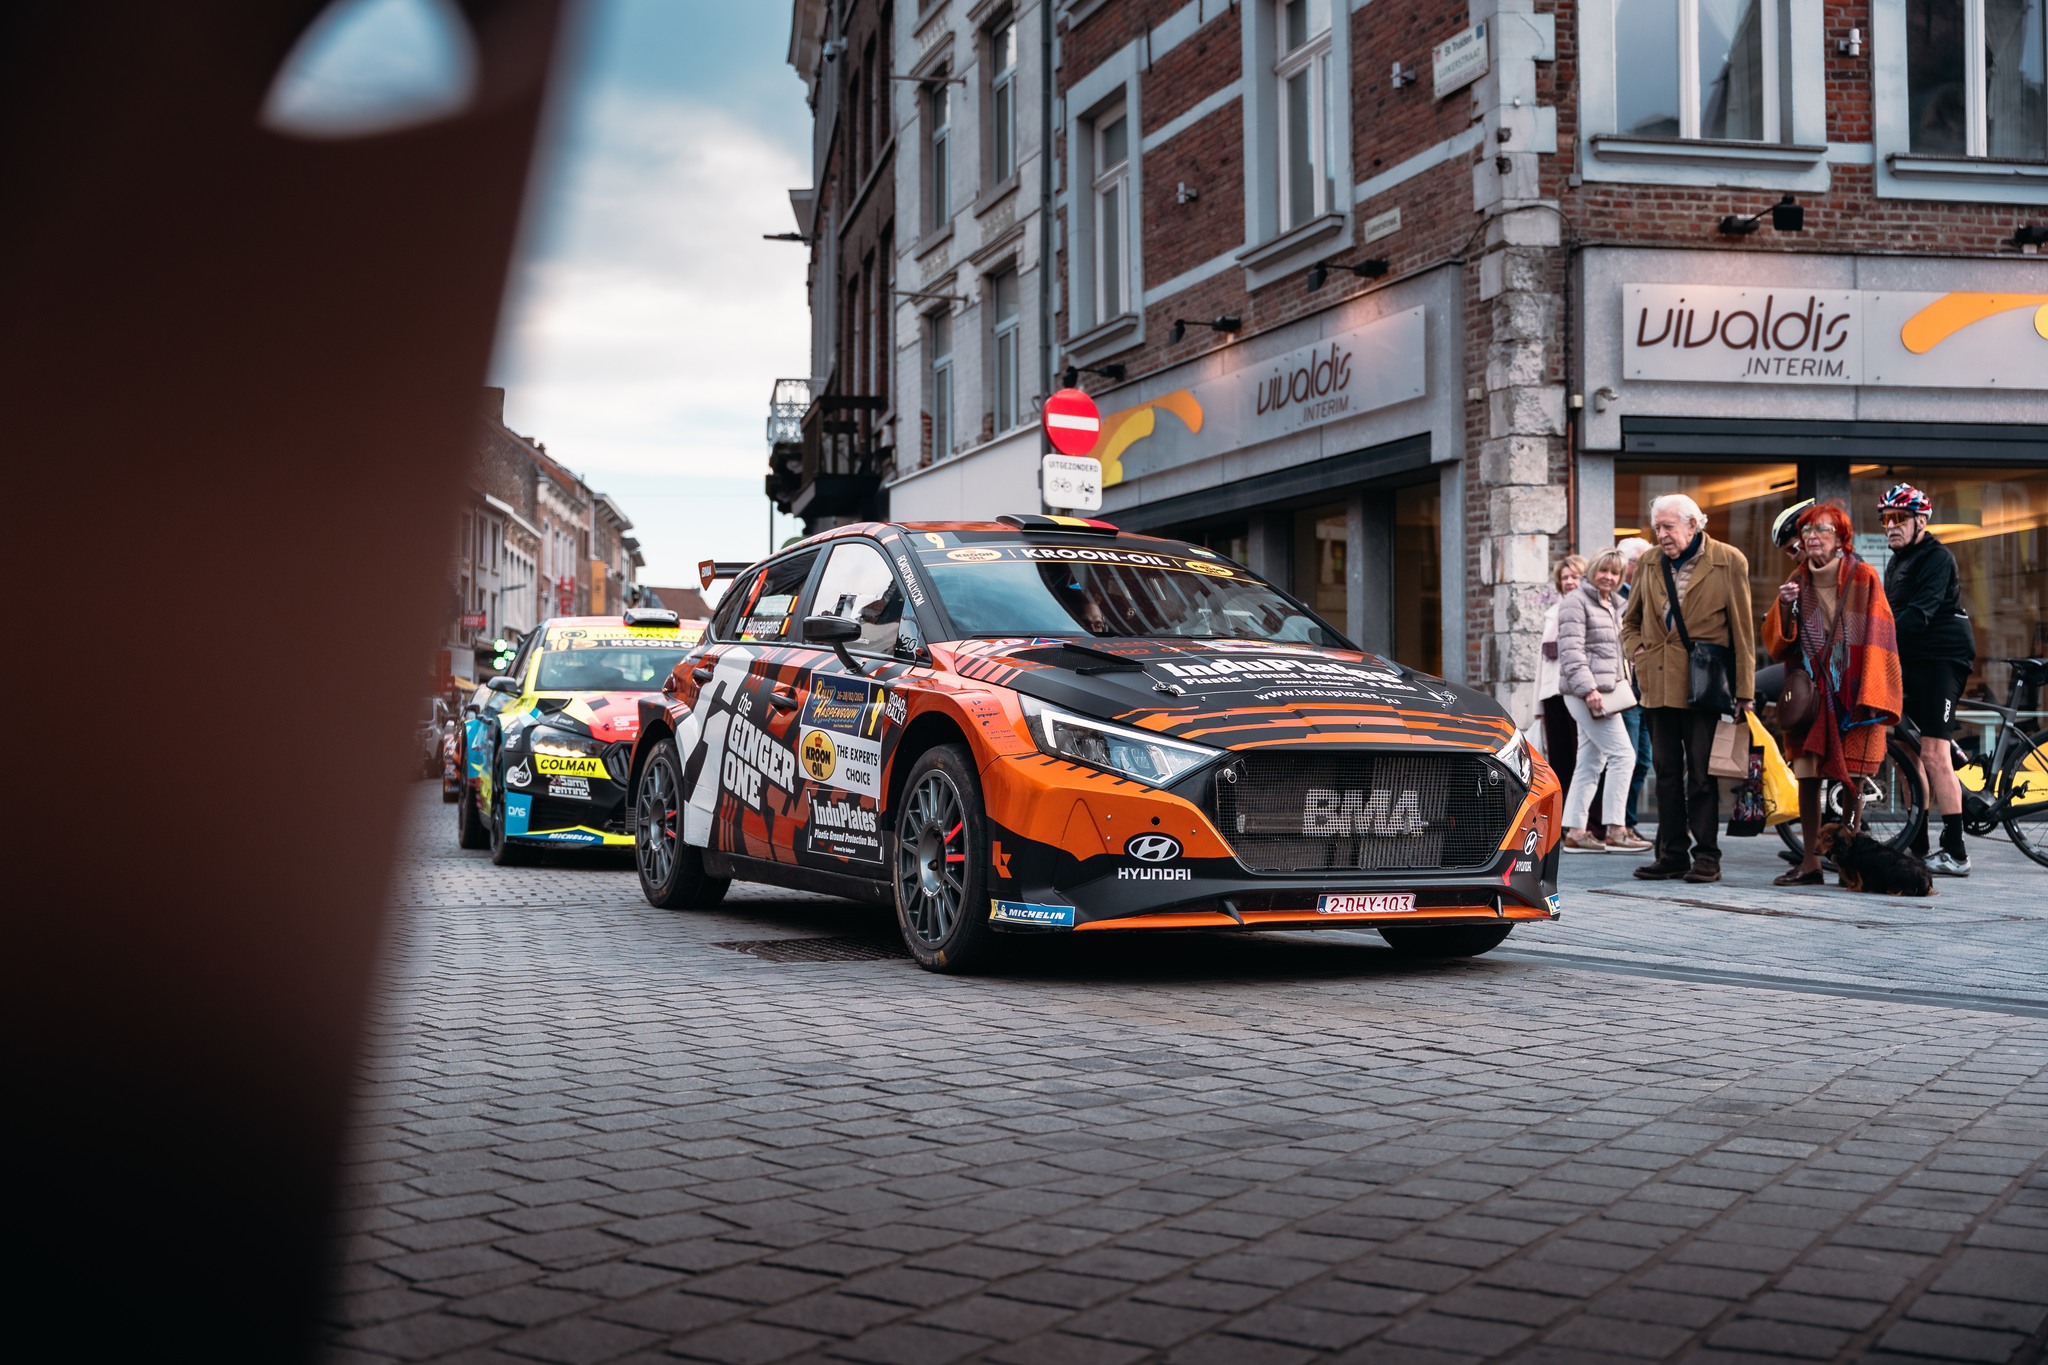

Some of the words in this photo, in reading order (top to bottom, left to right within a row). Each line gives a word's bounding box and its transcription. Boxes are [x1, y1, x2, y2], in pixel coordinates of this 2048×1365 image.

[1636, 294, 1851, 353] vivaldis
[1747, 357, 1844, 377] INTERIM
[1257, 342, 1352, 416] vivaldis
[1303, 395, 1349, 423] INTERIM
[1048, 461, 1099, 473] UITGEZONDERD
[925, 532, 946, 549] 9
[1021, 548, 1171, 567] KROON-OIL
[743, 616, 782, 638] Huysegems
[1157, 658, 1403, 684] InduPlates
[1242, 672, 1302, 680] Ground
[737, 692, 752, 717] the
[888, 691, 906, 712] ROAD
[867, 688, 885, 736] 9
[885, 703, 906, 726] RALLY
[728, 713, 795, 794] GINGER
[805, 746, 831, 765] KROON
[837, 744, 848, 759] THE
[541, 759, 597, 773] COLMAN
[812, 762, 823, 777] OIL
[723, 751, 761, 811] ONE
[846, 768, 871, 786] CHOICE
[508, 806, 526, 816] DAS
[812, 799, 877, 833] InduPlates
[1302, 788, 1424, 838] BMA
[548, 832, 595, 841] MICHELIN
[814, 828, 829, 840] Plastic
[829, 830, 845, 842] Ground
[867, 836, 879, 847] Mats
[1117, 867, 1191, 881] HYUNDAI
[1515, 860, 1533, 872] HYUNDAI
[1008, 907, 1066, 920] MICHELIN
[1330, 896, 1410, 912] 2-DHY-103
